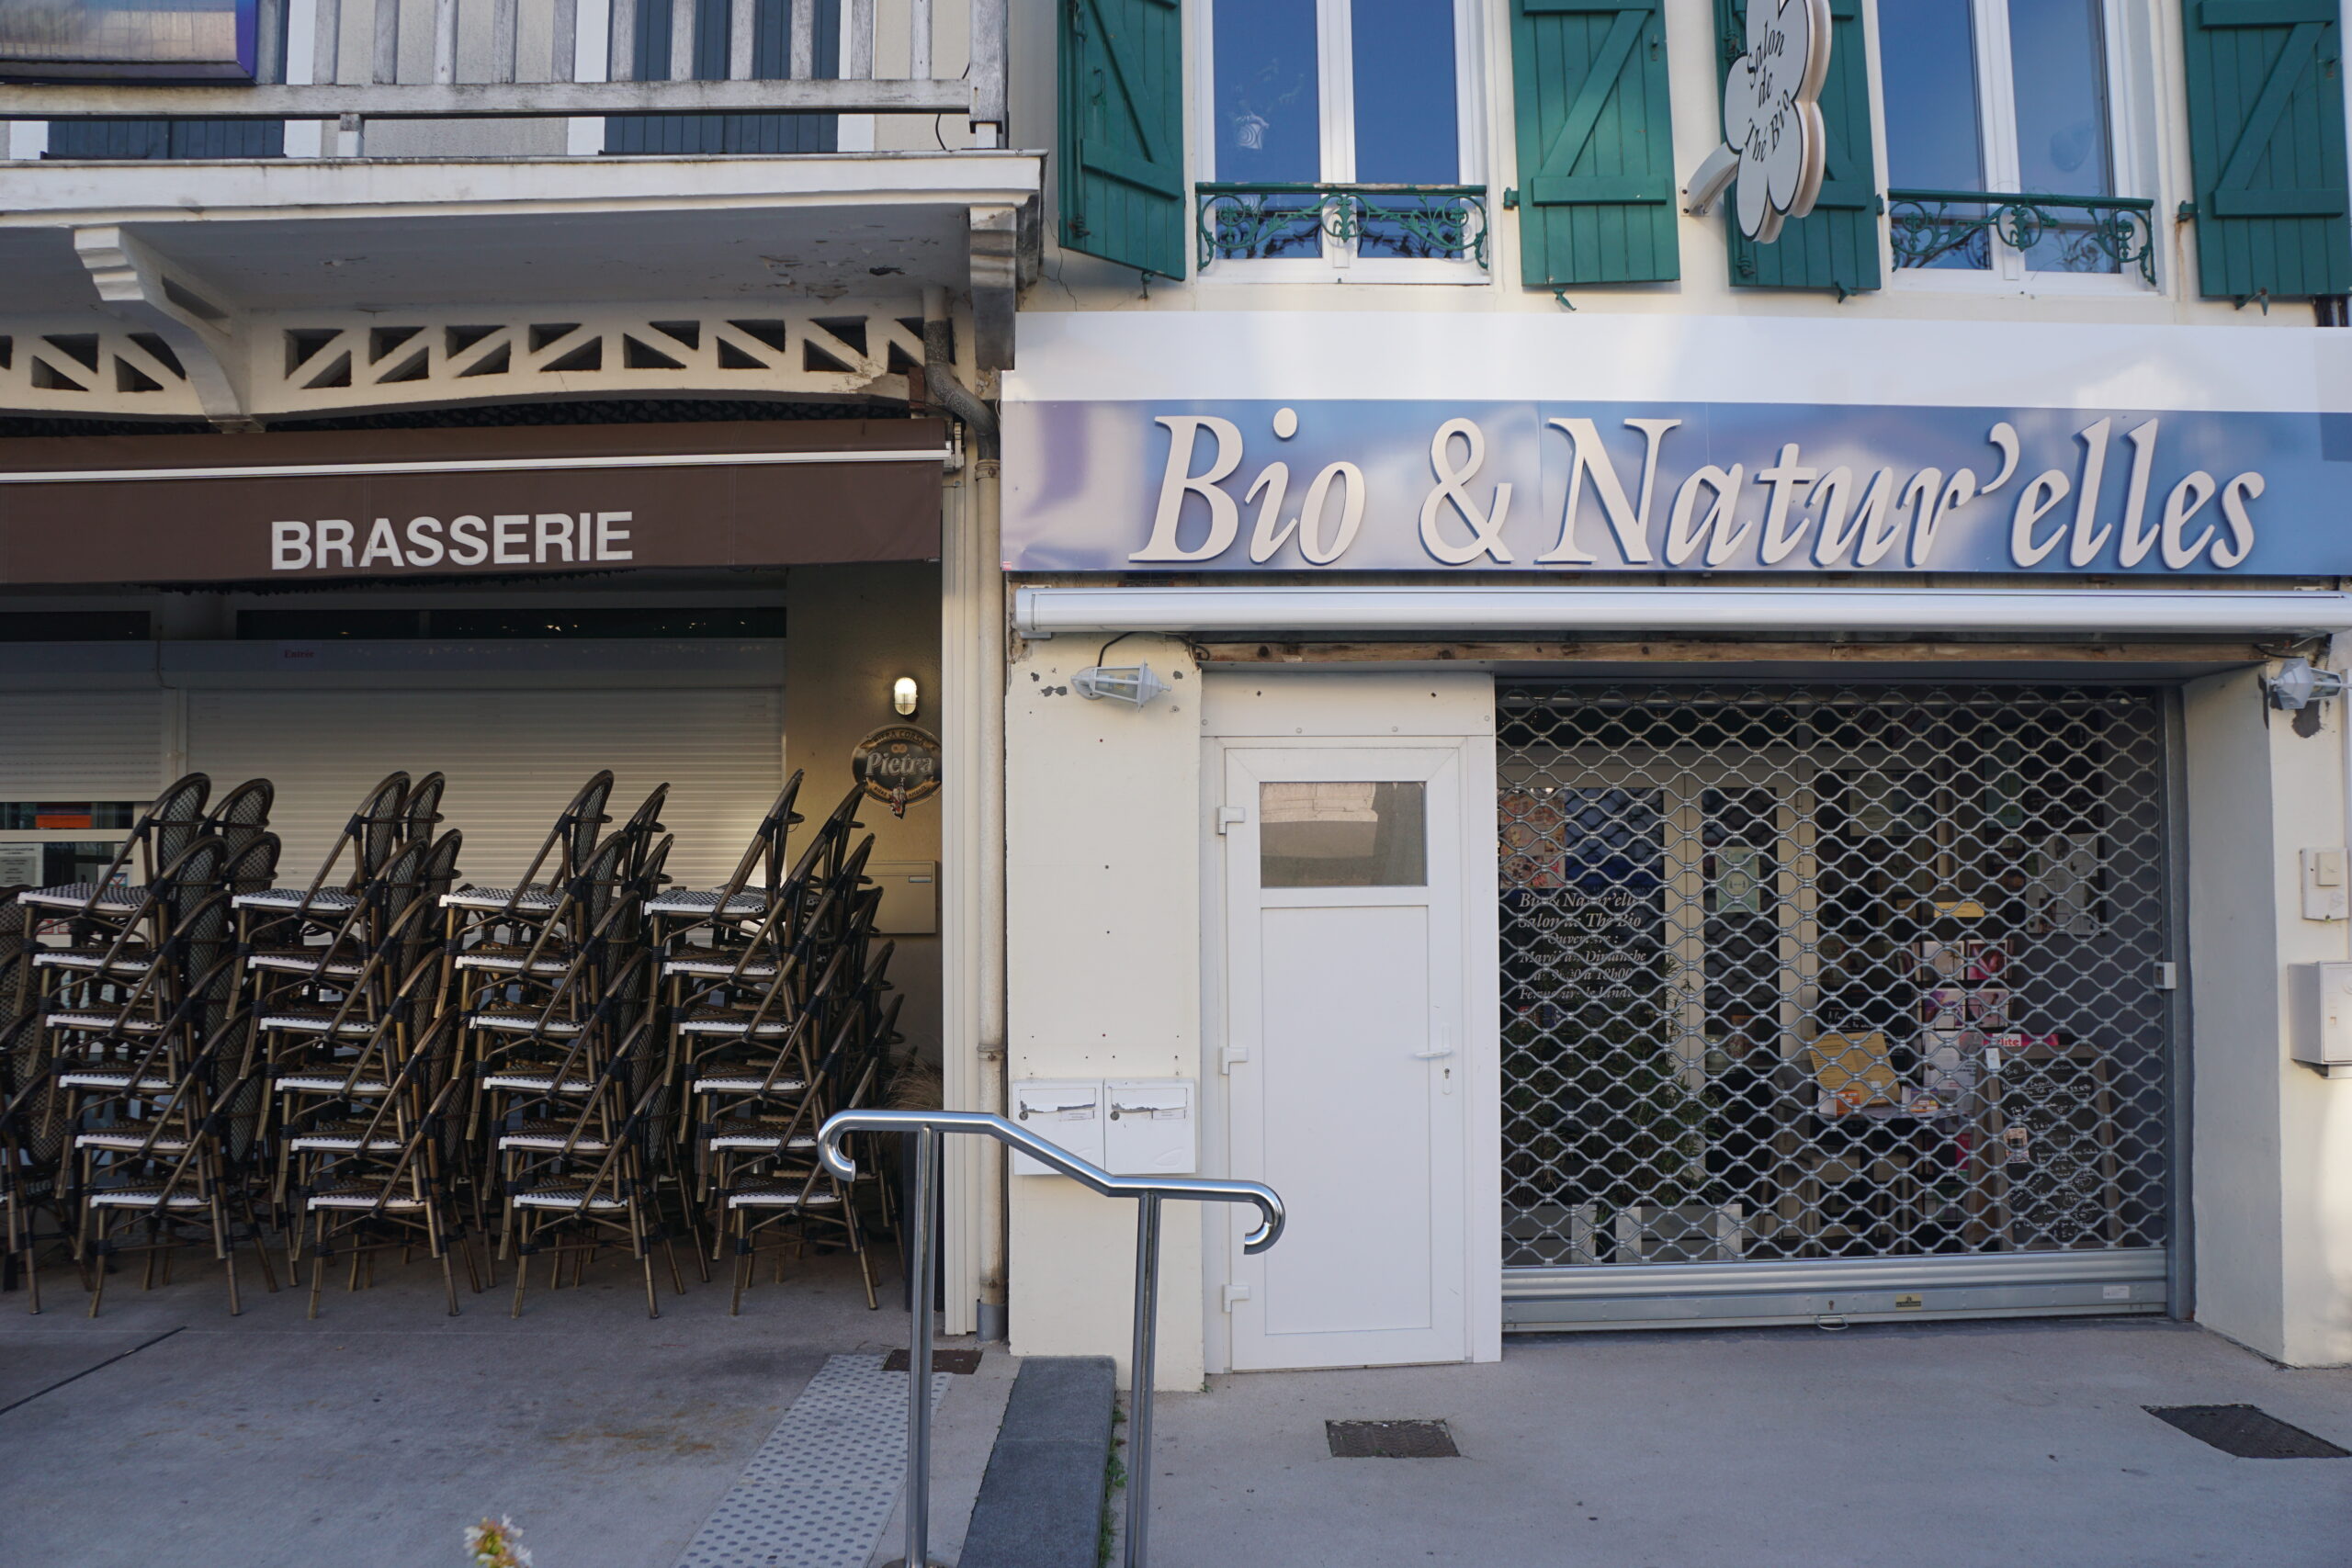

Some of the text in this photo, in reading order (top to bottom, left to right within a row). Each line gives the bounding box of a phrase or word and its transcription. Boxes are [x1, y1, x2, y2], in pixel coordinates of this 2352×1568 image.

[1747, 20, 1784, 89] Salon
[1758, 64, 1773, 108] de
[1744, 89, 1791, 162] Thé Bio
[1128, 406, 2266, 570] Bio & Natur'elles
[271, 512, 633, 570] BRASSERIE
[865, 750, 934, 777] Pietra
[1519, 892, 1544, 908] Bi
[1563, 892, 1643, 908] Nar'ell
[1547, 931, 1611, 944] Ouverre
